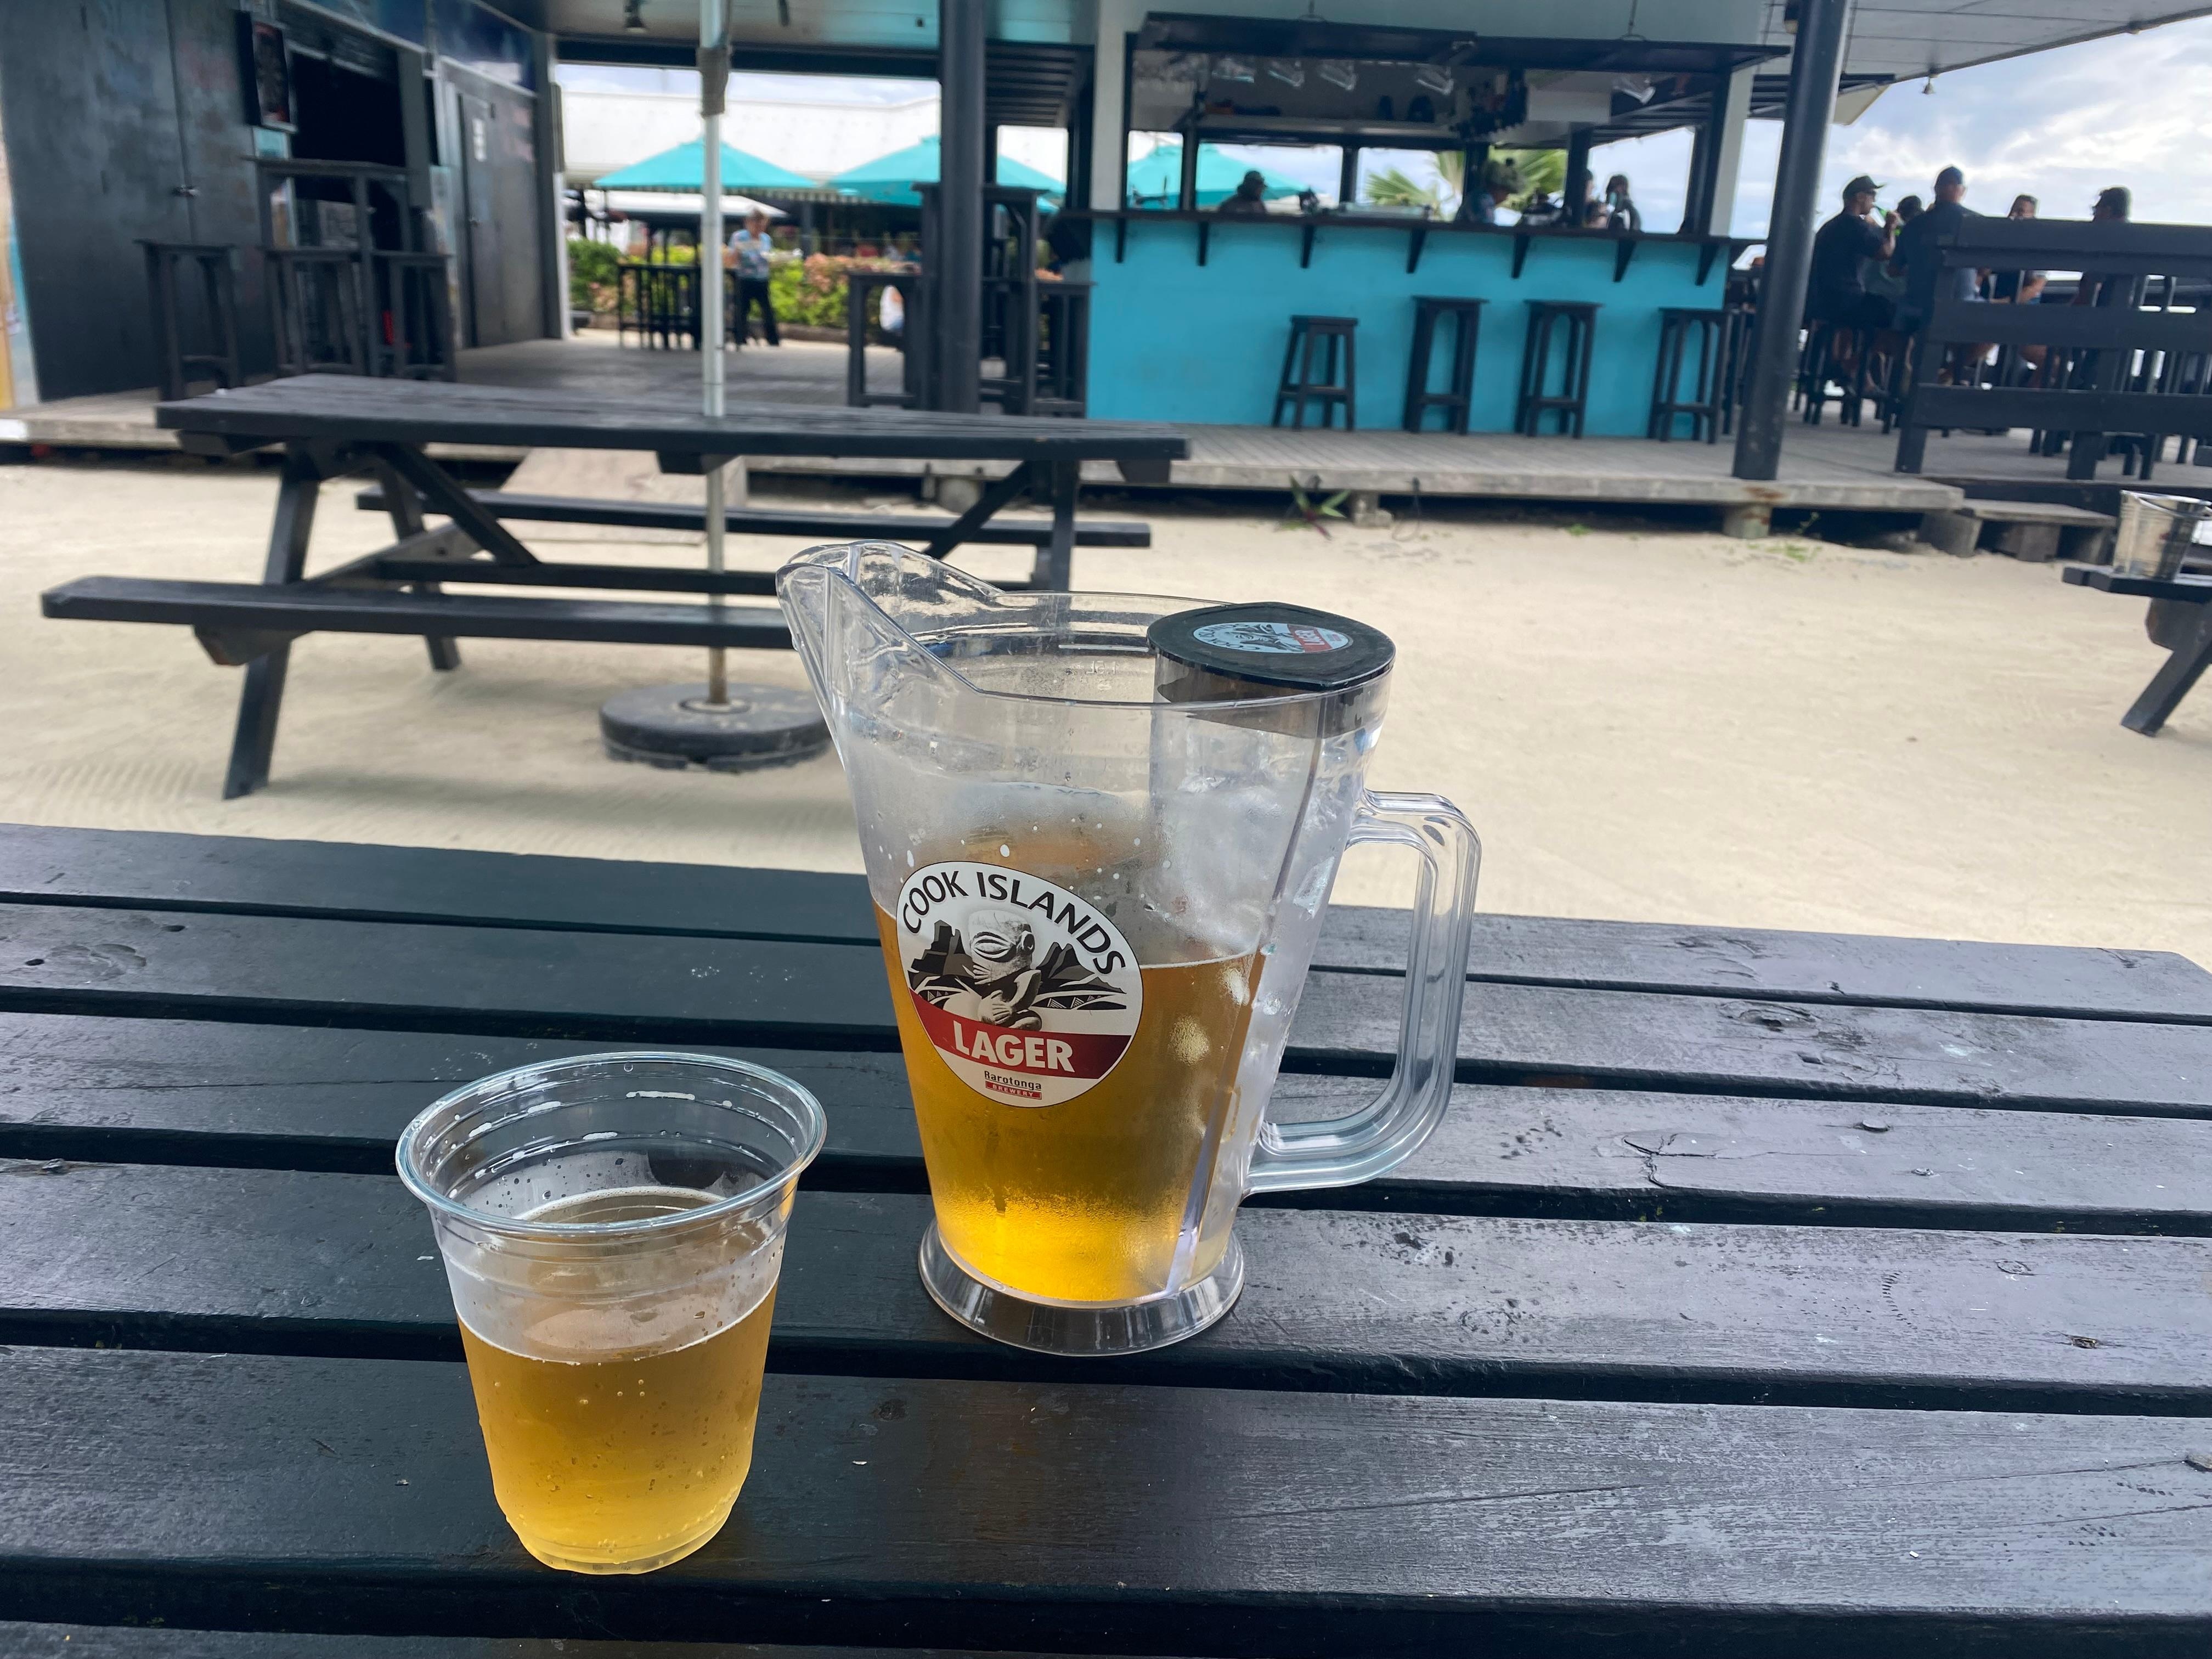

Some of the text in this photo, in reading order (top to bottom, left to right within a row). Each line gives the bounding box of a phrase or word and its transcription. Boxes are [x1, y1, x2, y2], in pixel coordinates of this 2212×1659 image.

[903, 871, 1126, 974] COOK ISLANDS
[953, 1020, 1075, 1073] LAGER
[984, 1070, 1042, 1091] Rarotonga
[992, 1084, 1034, 1097] BREWERY
